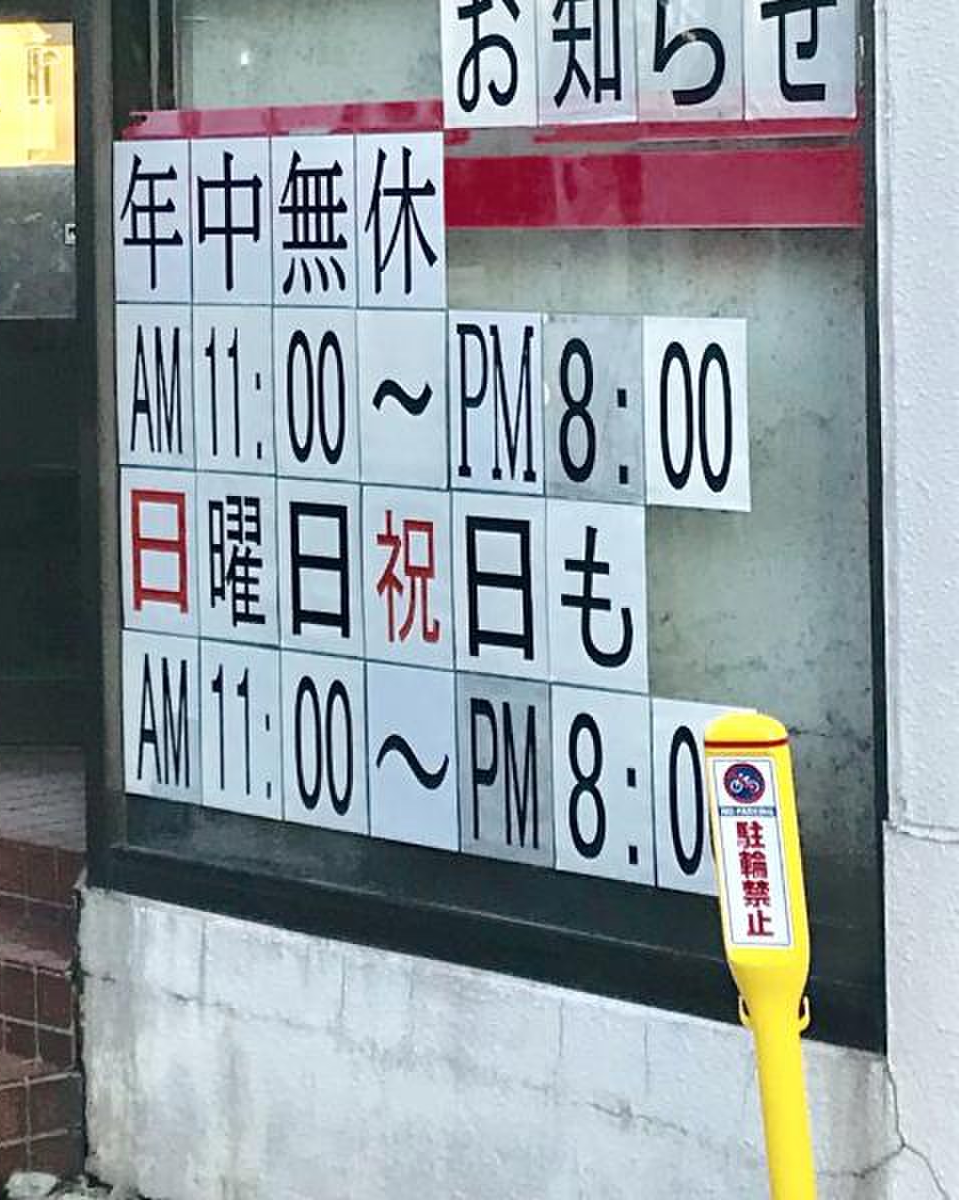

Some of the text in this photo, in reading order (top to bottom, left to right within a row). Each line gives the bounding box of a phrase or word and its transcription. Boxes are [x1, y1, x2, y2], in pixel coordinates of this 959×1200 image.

[120, 147, 437, 294] 年中無休
[131, 488, 633, 668] 日曜日祝日も
[137, 652, 705, 876] AM11:00～PM8:0
[736, 821, 775, 938] 駐輪禁止
